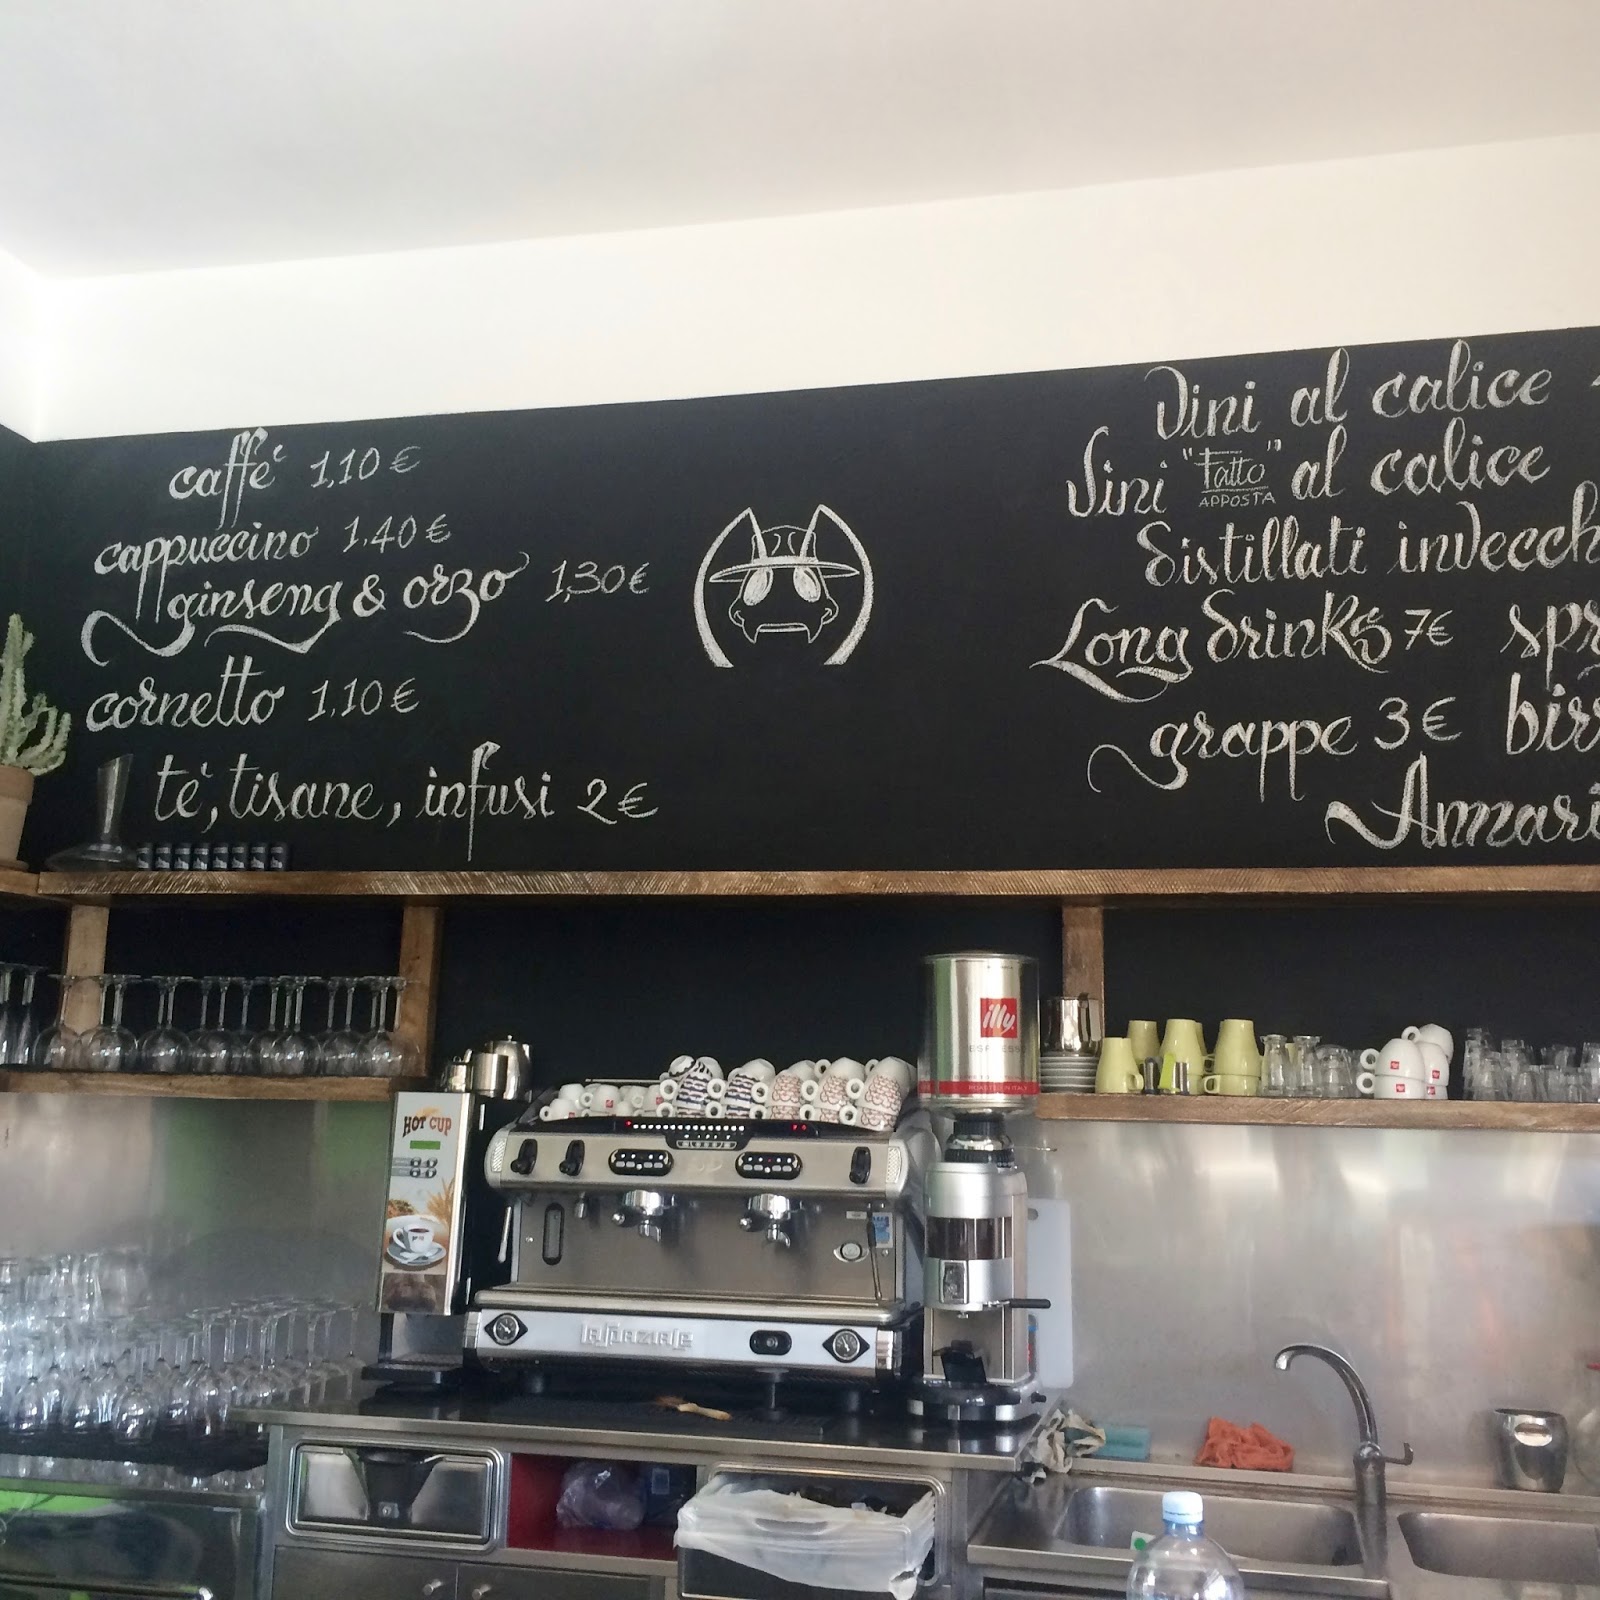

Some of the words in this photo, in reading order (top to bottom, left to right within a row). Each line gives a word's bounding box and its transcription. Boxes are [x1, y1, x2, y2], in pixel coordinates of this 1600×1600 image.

[1290, 347, 1351, 427] al
[1370, 339, 1553, 419] calice
[1198, 490, 1277, 508] APPOSTA
[1290, 422, 1348, 501] al
[1369, 416, 1551, 497] calice
[80, 578, 344, 668] ginseng
[352, 573, 387, 618] &
[402, 551, 531, 644] orzo
[93, 521, 320, 623] cappuccino
[85, 654, 286, 733] cornetto
[1029, 598, 1194, 702] Long
[1086, 710, 1359, 803] grappe
[415, 740, 556, 862] infusi
[982, 1003, 1016, 1035] illy
[402, 1115, 426, 1137] HOT
[429, 1116, 452, 1136] CUP
